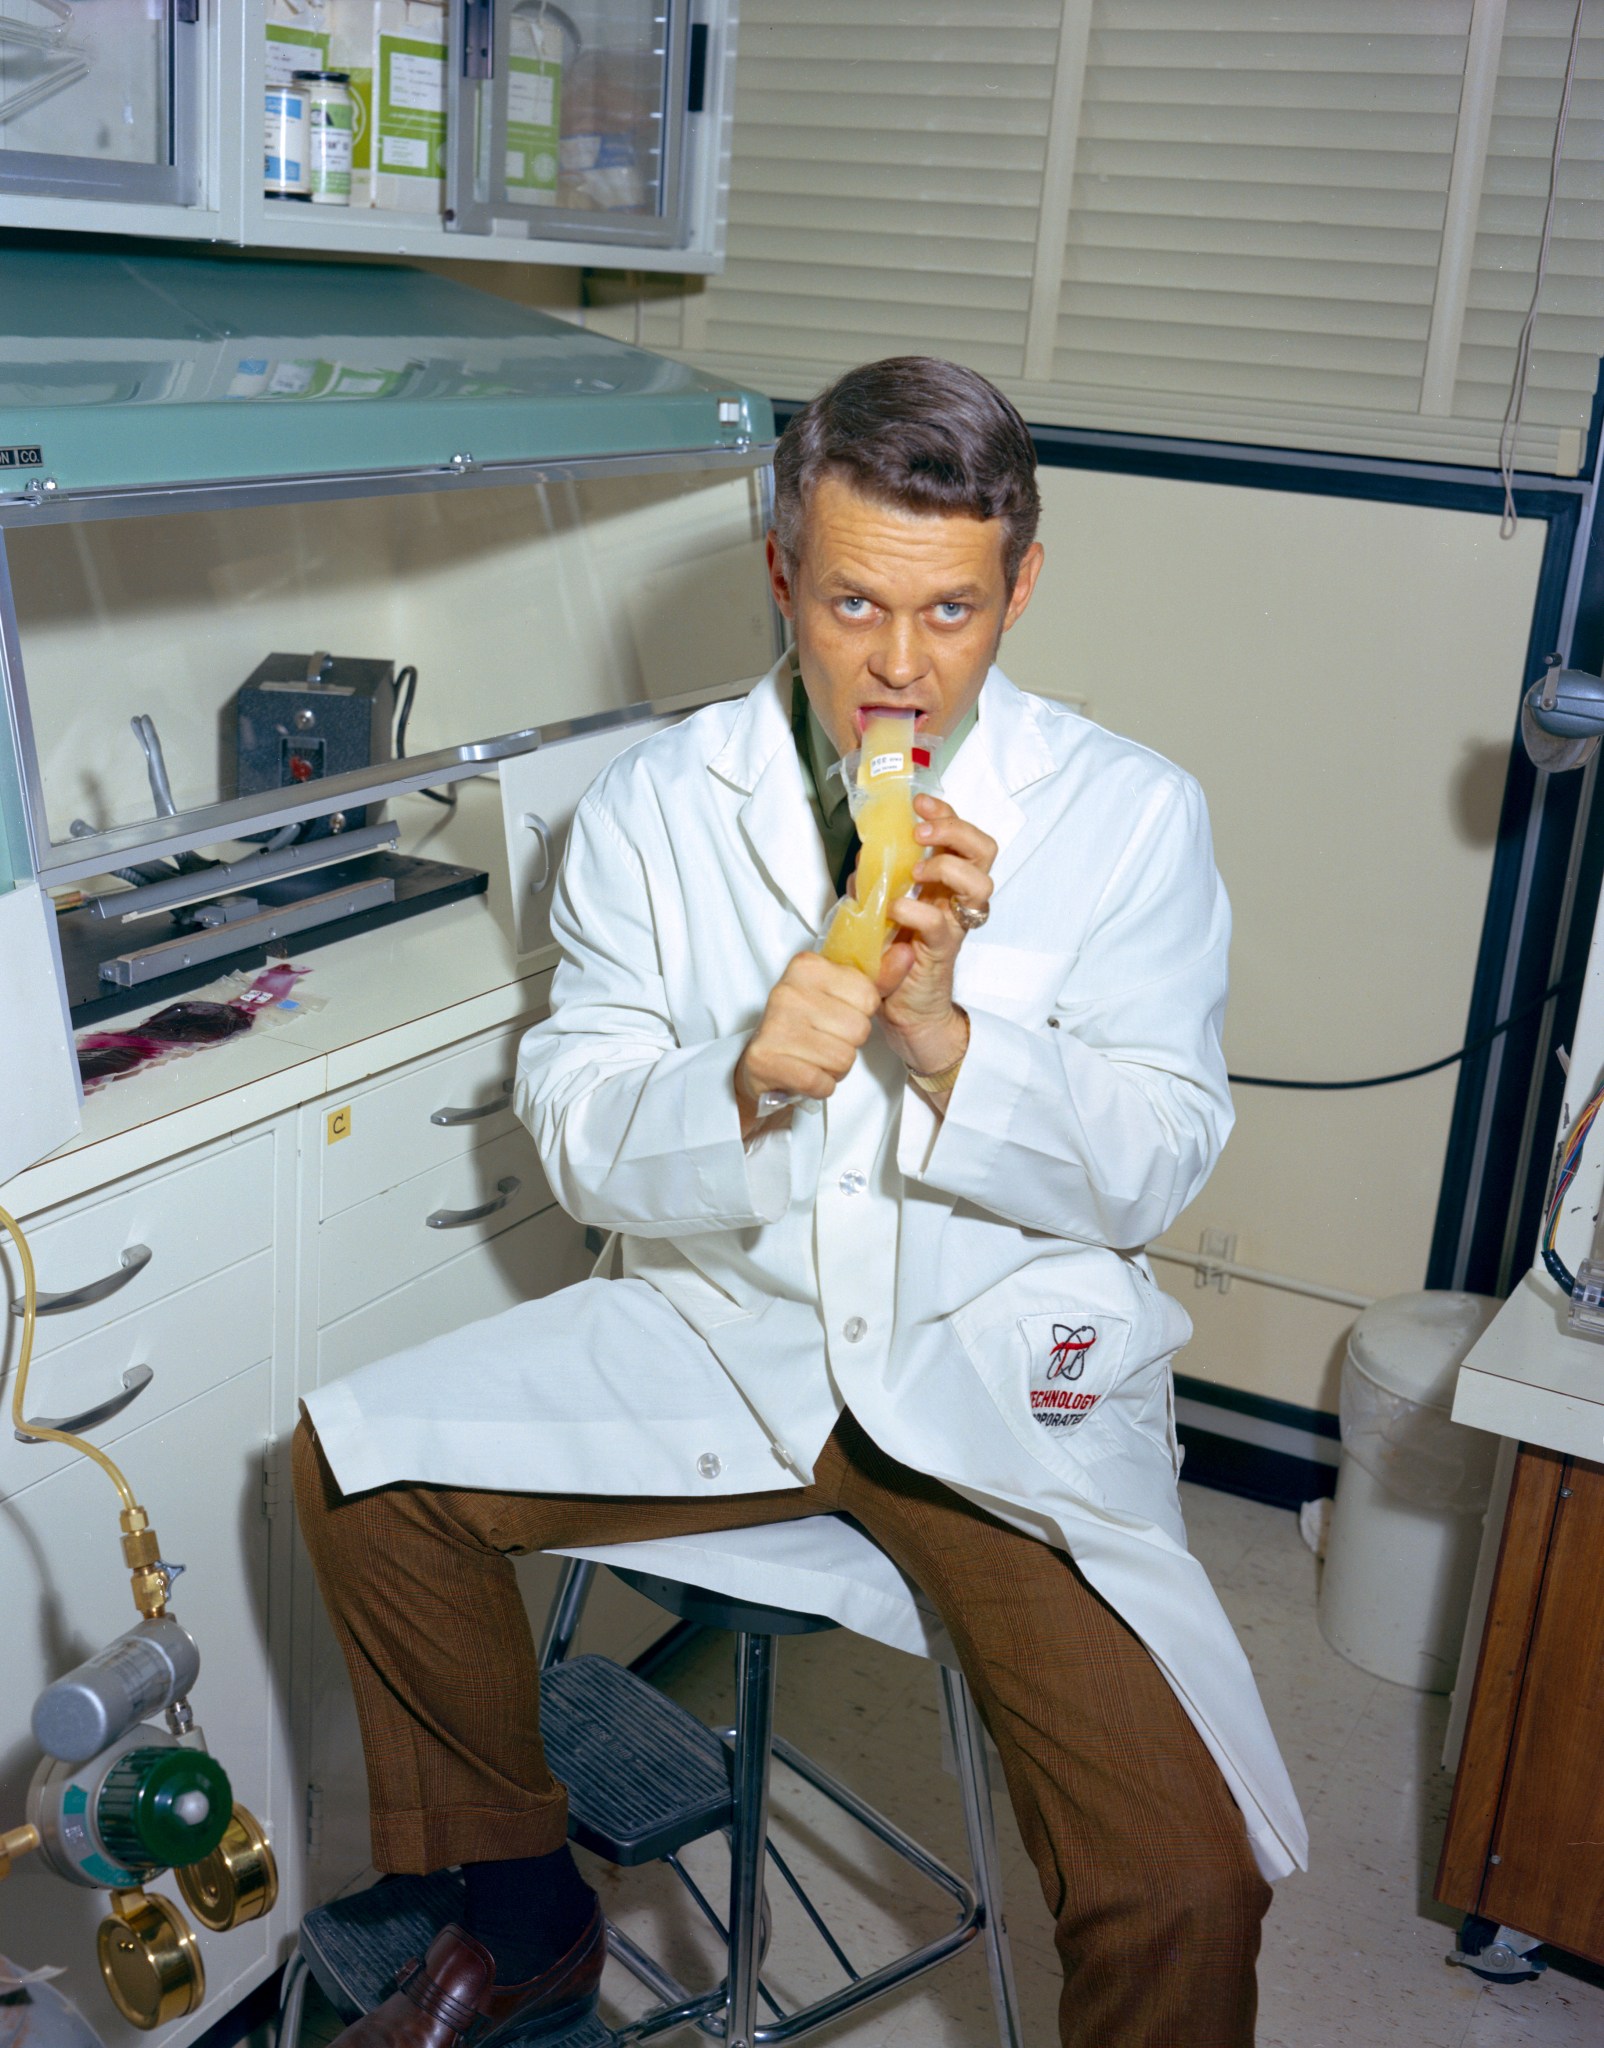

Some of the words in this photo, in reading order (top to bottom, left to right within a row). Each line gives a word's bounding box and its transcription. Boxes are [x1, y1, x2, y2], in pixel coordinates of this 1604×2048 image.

[0, 451, 10, 464] N
[20, 450, 40, 463] CO.
[333, 1113, 346, 1134] C
